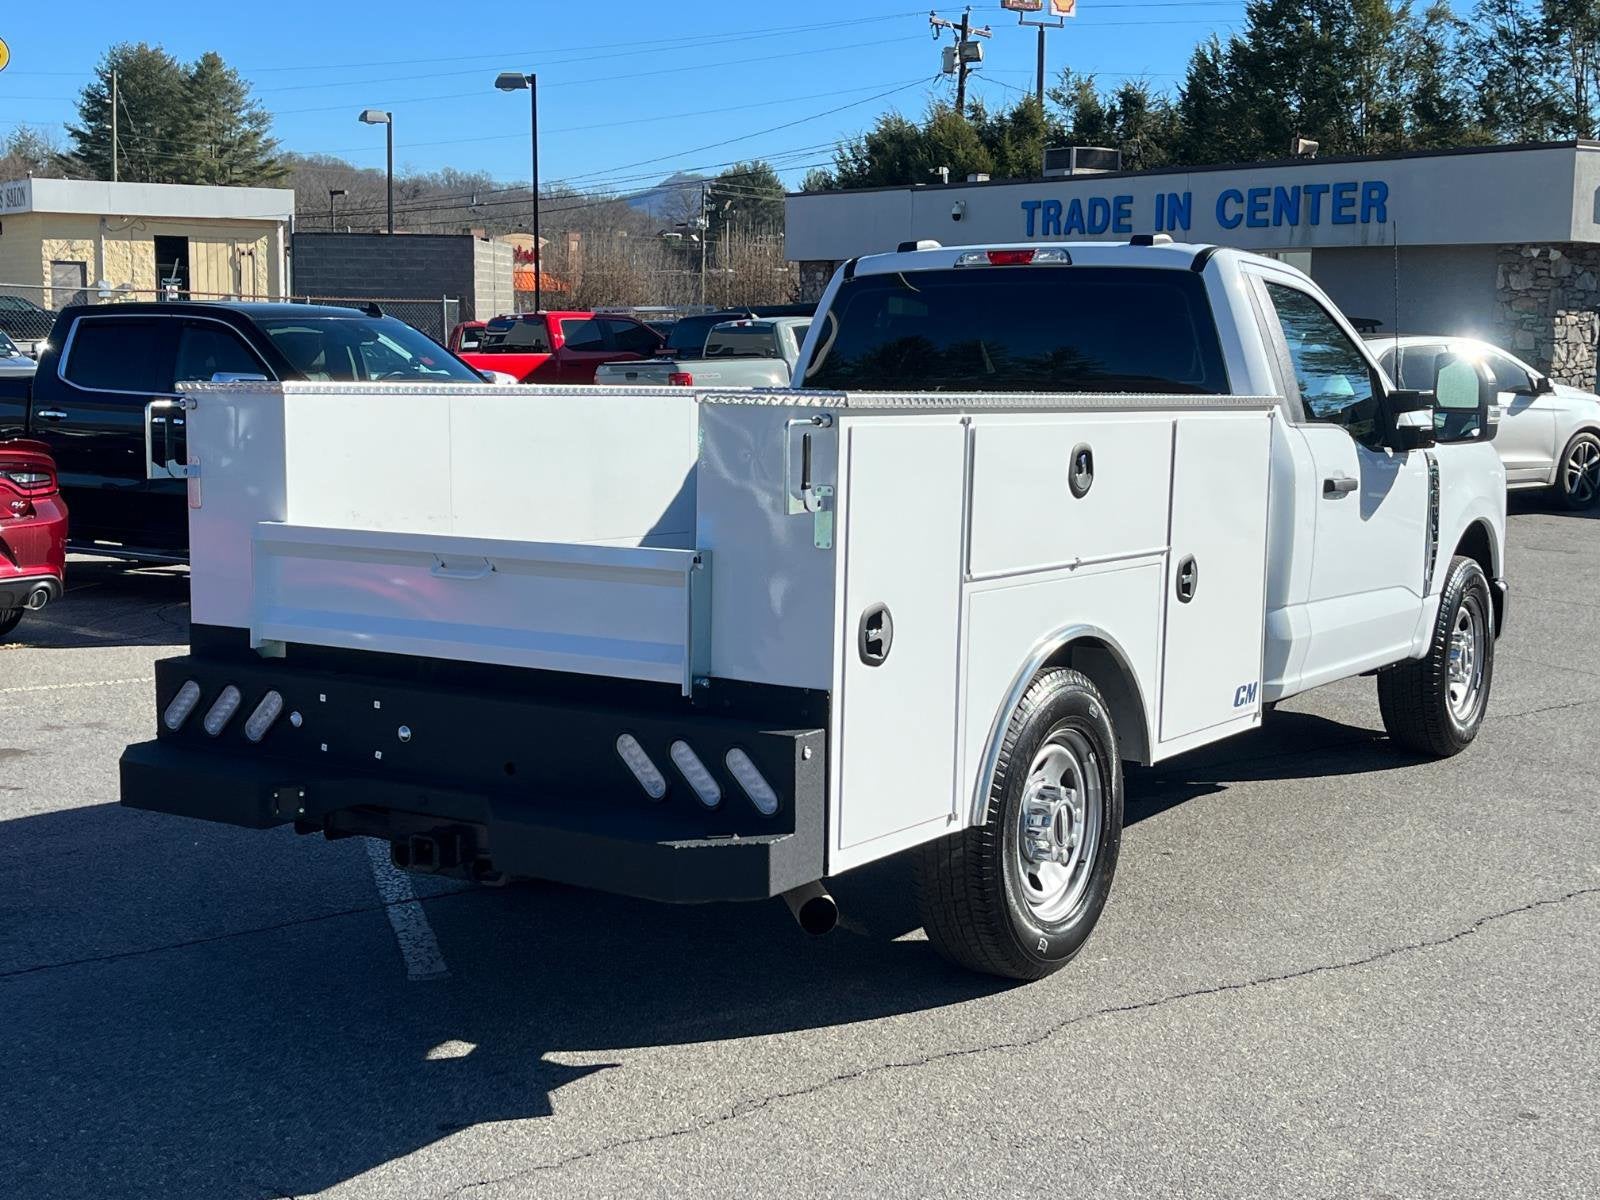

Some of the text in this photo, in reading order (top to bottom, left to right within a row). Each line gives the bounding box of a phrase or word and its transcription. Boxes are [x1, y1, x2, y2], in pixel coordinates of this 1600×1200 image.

[6, 186, 26, 208] SALON
[1021, 181, 1389, 237] TRADE IN CENTER
[1233, 681, 1258, 708] CM
